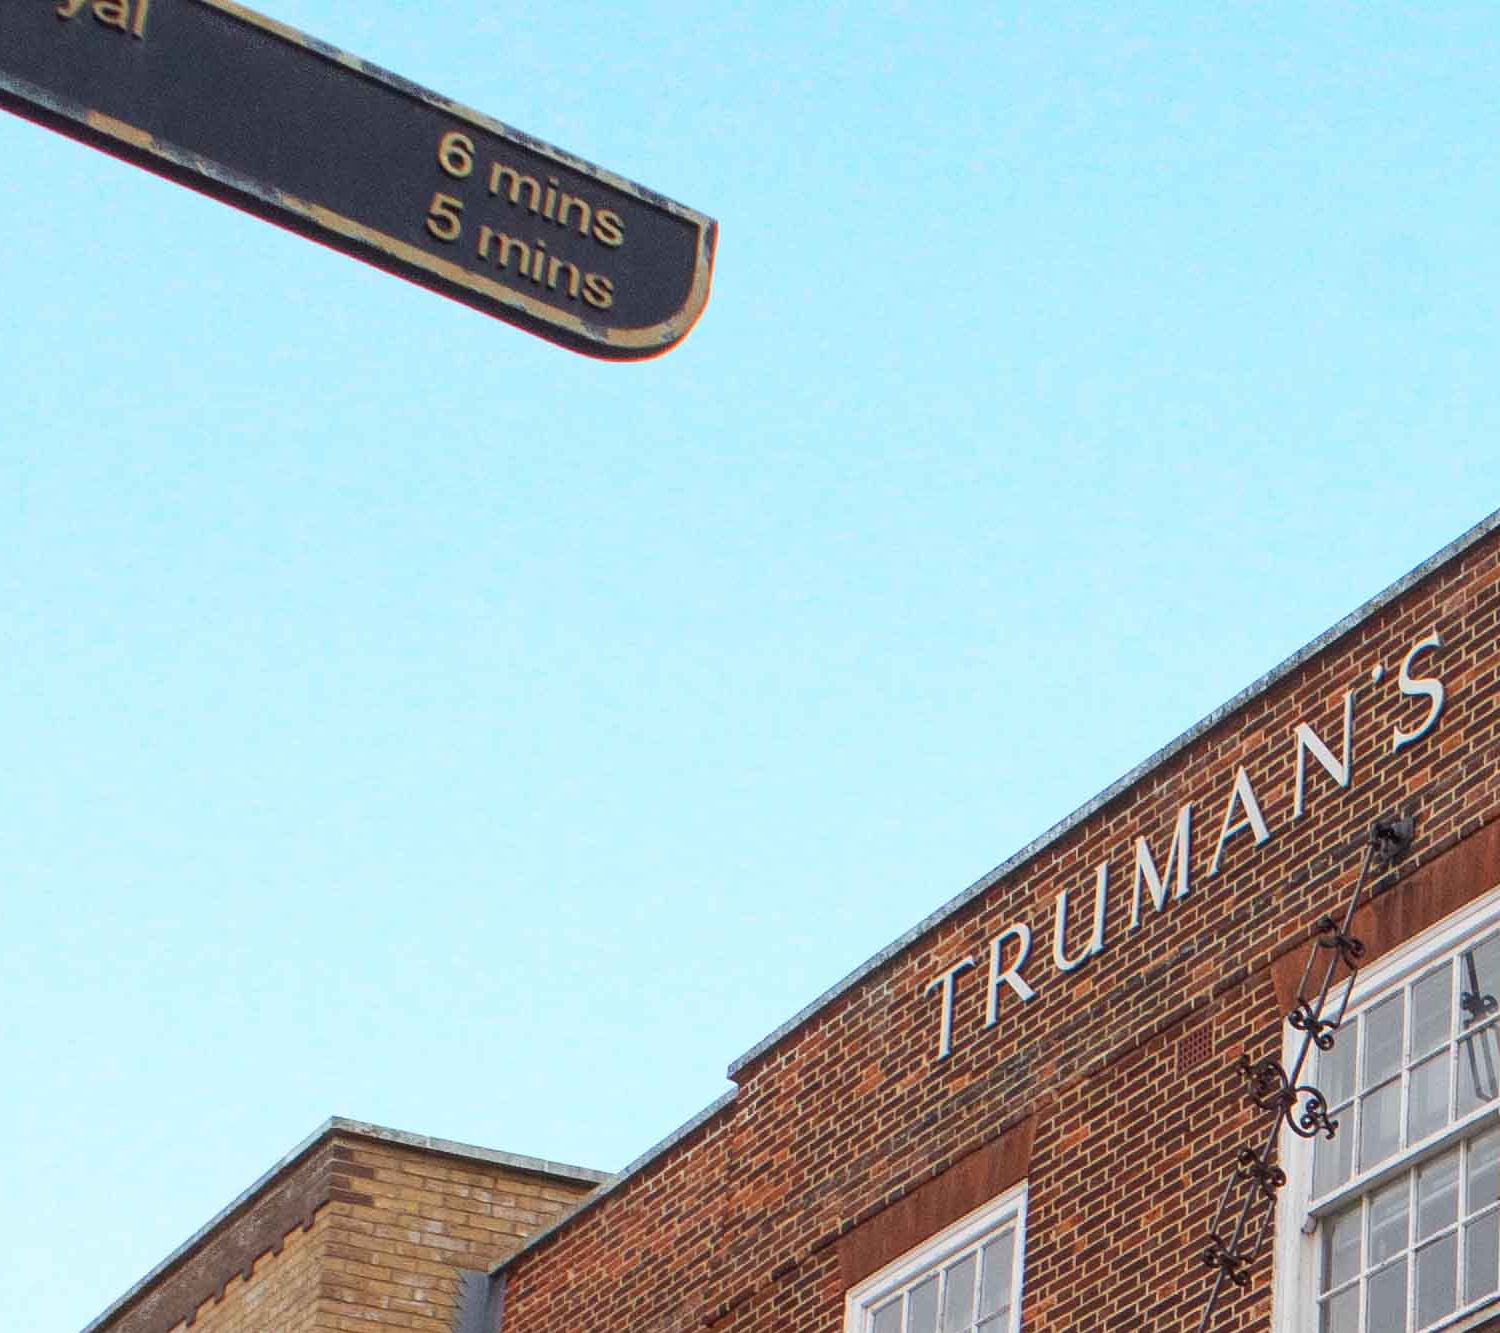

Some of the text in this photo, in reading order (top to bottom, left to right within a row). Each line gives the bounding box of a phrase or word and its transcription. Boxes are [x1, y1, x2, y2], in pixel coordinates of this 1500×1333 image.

[439, 131, 626, 249] 6 mins
[426, 192, 615, 310] 5 mins
[924, 632, 1448, 1060] TRUMAN'S
